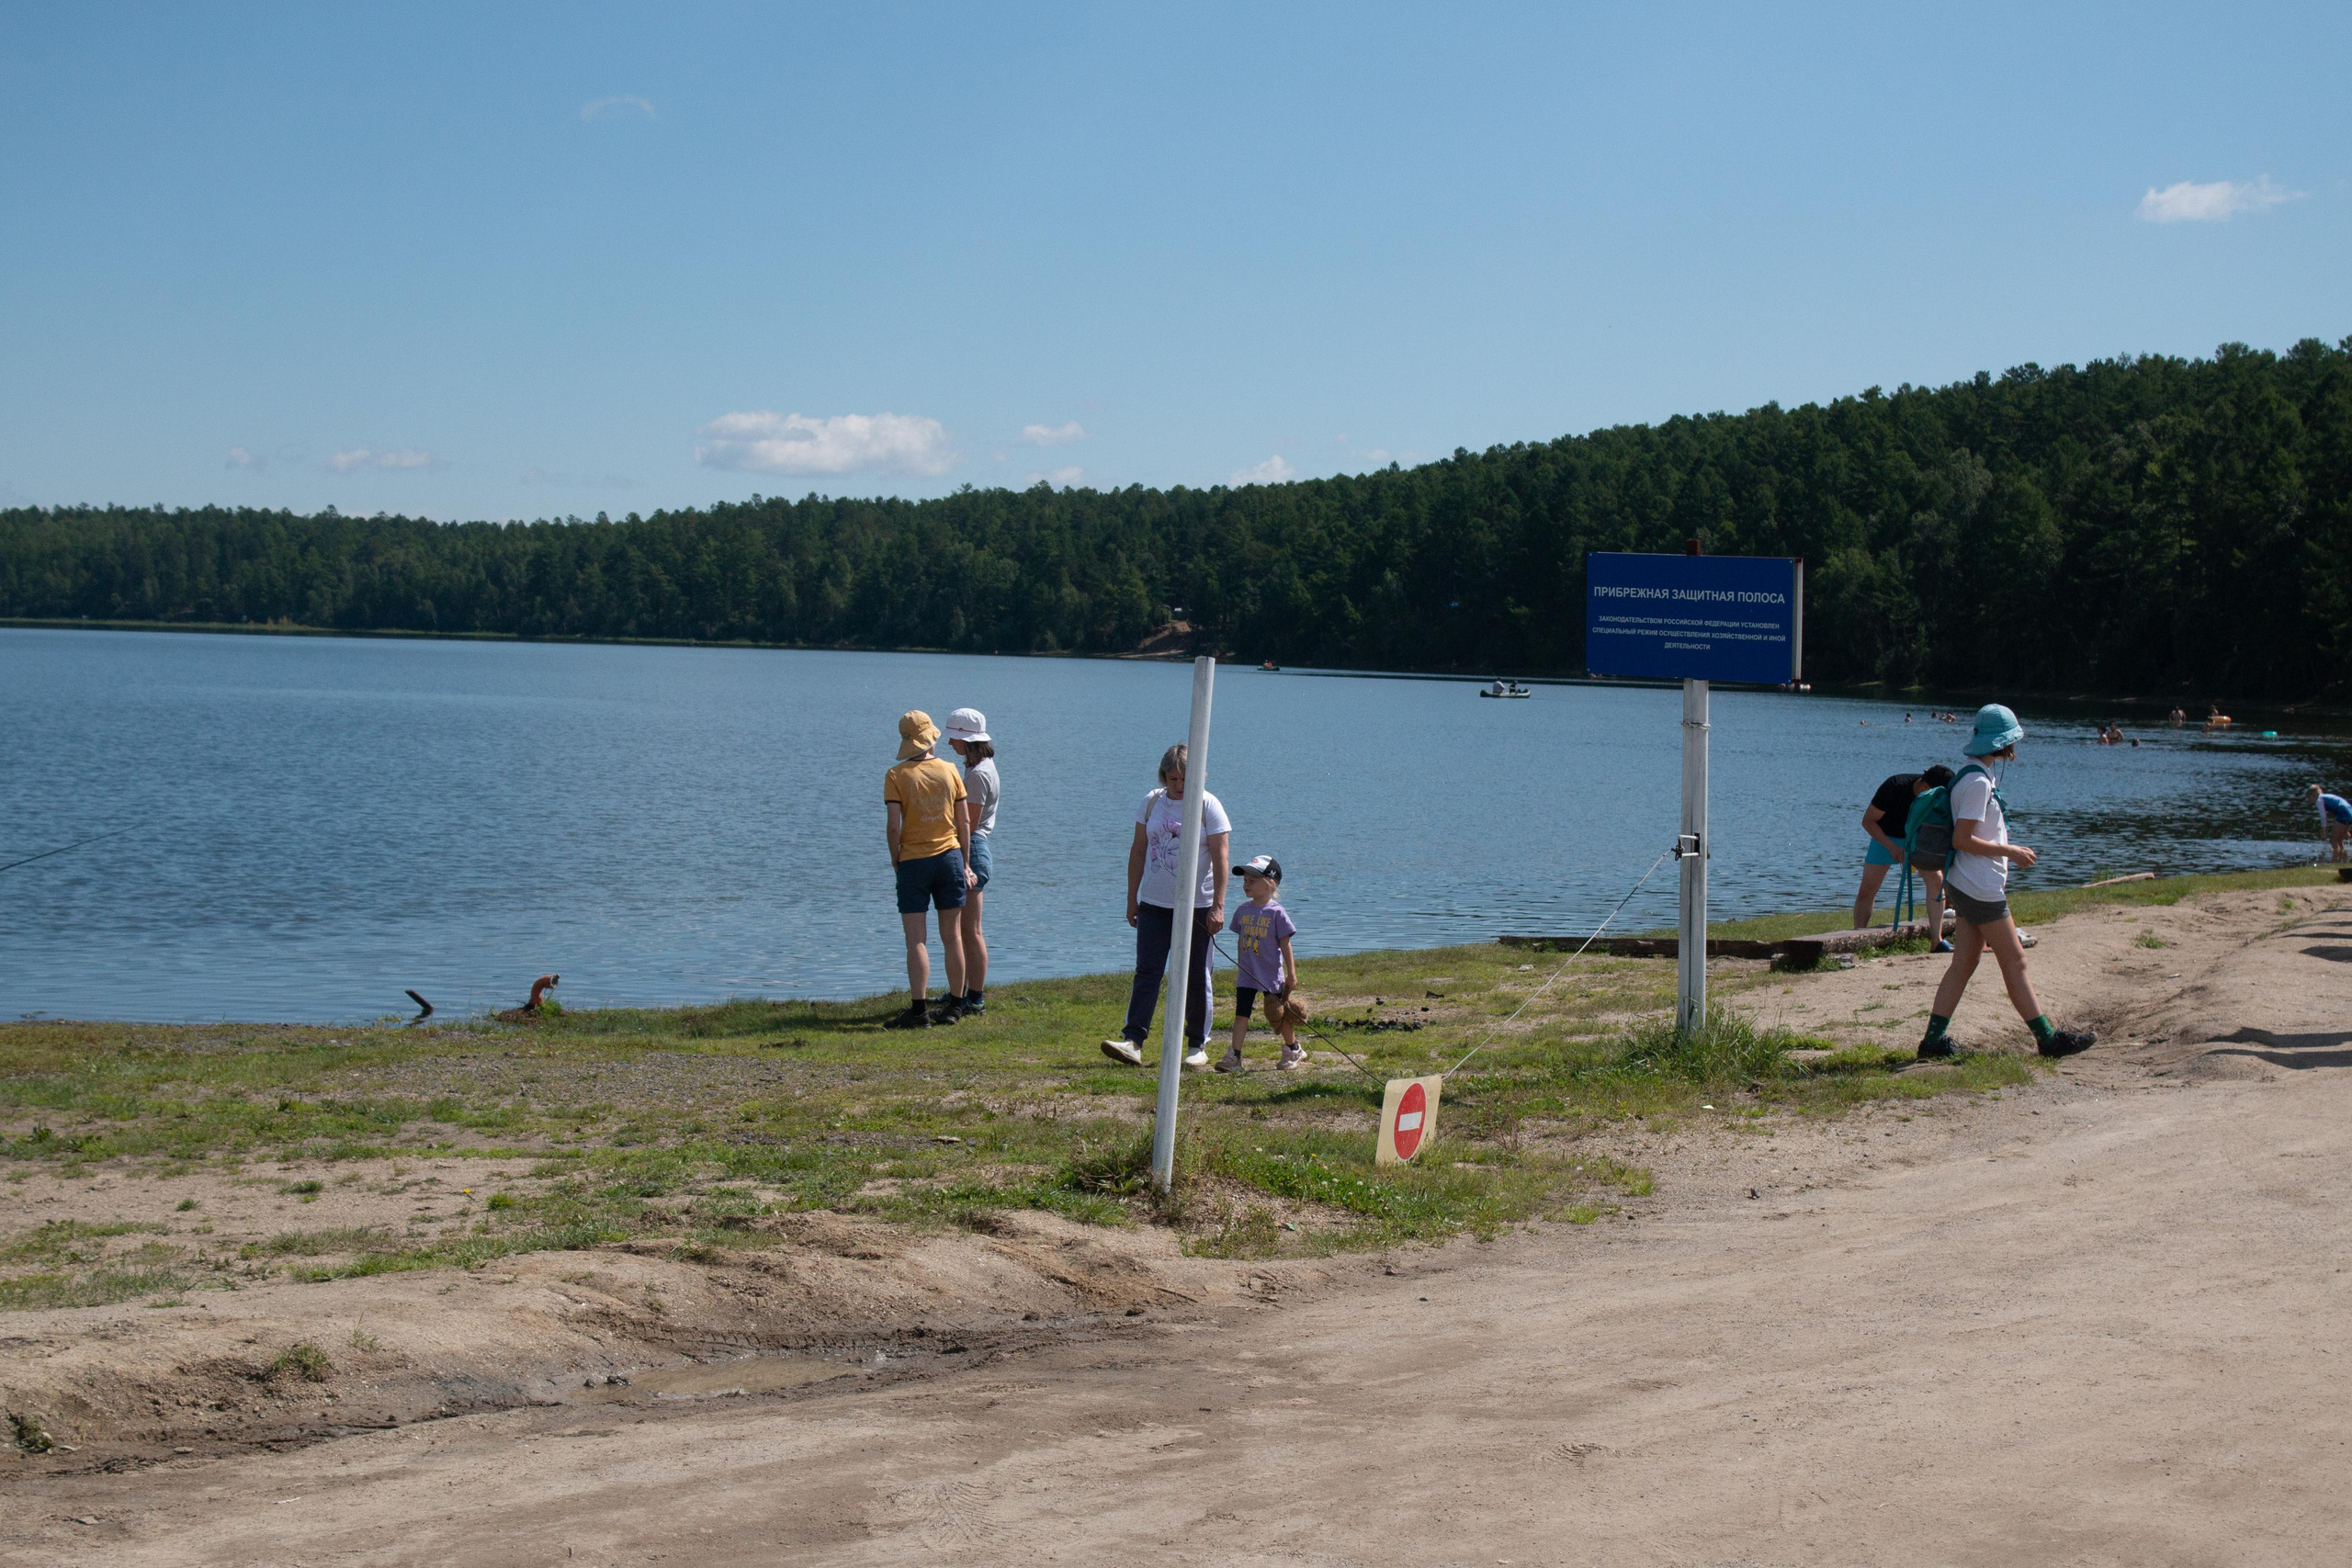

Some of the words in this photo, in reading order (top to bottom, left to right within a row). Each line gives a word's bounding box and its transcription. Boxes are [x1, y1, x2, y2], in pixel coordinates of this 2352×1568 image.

[1594, 586, 1669, 599] ПРИБРЕЖНАЯ
[1671, 589, 1735, 602] ЗАЩИТНАЯ
[1737, 592, 1785, 604] ПОЛОСА
[1599, 615, 1663, 625] ЗАКОНОДАТЕЛЬСТВОМ
[1592, 626, 1636, 635] СПЕЦИАЛЬНЫЙ
[1658, 629, 1711, 638] ОСУЩЕСТВЛЕНИЯ
[1711, 632, 1762, 641] ХОЗЯЙСТВЕННОЙ
[1664, 642, 1711, 650] ДЕЯТЕЛЬНОСТИ
[1257, 916, 1272, 928] LIKE
